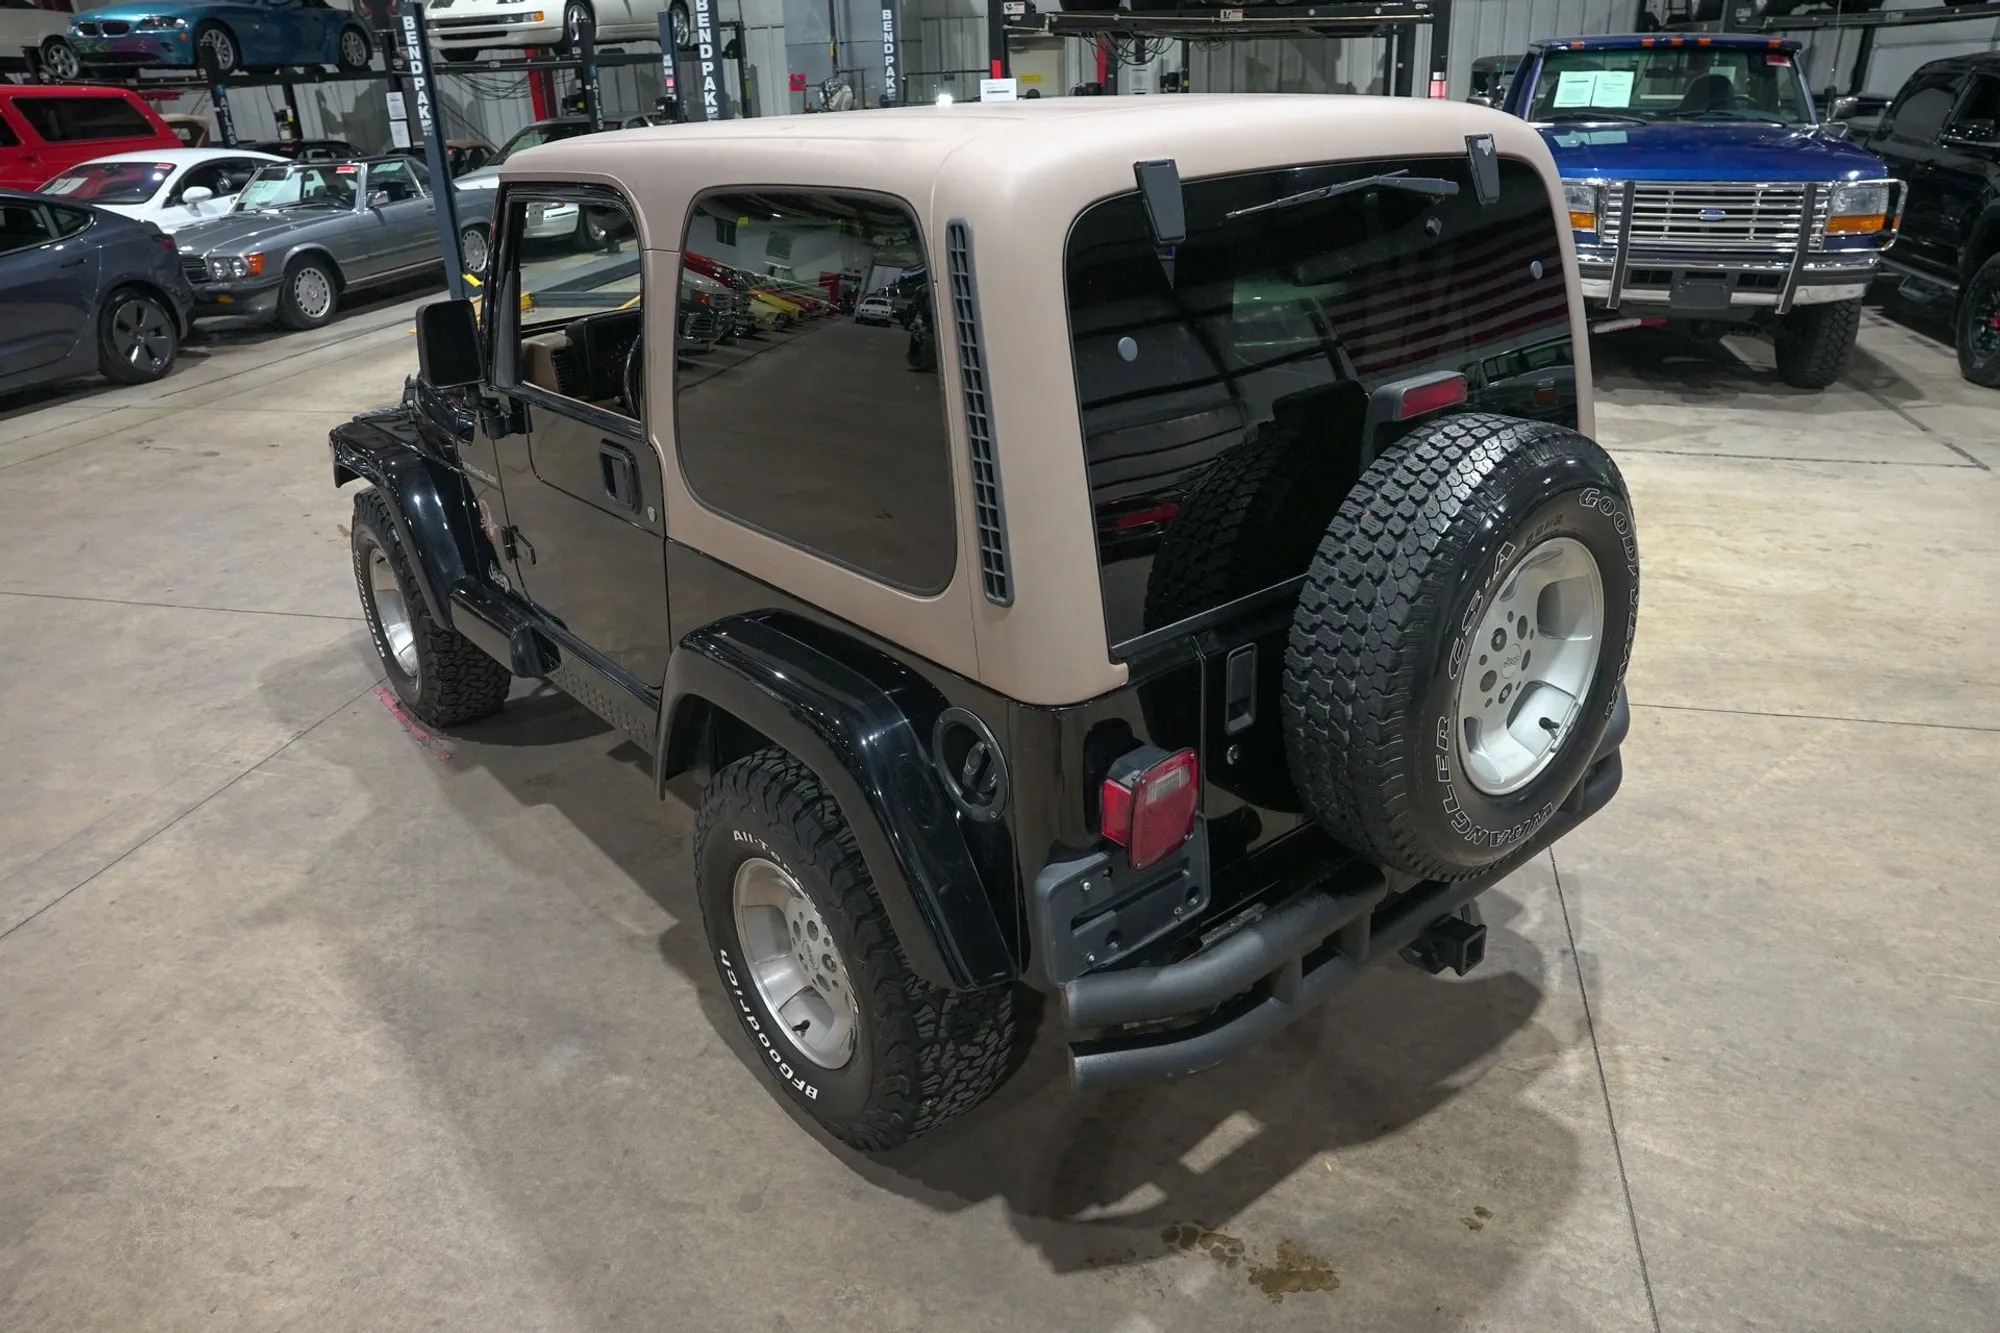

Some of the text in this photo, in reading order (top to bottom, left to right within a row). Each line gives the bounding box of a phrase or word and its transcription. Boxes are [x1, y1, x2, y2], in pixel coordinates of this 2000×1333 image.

[402, 15, 431, 119] BENDPAK
[695, 0, 718, 106] BENDPAK
[882, 9, 897, 88] BENDPAK
[220, 96, 238, 145] ATLAS
[592, 78, 605, 130] ATLAS
[1579, 487, 1640, 721] GOODYEAR
[1436, 715, 1553, 847] WRANGLER
[719, 948, 819, 1101] BFGoodrich
